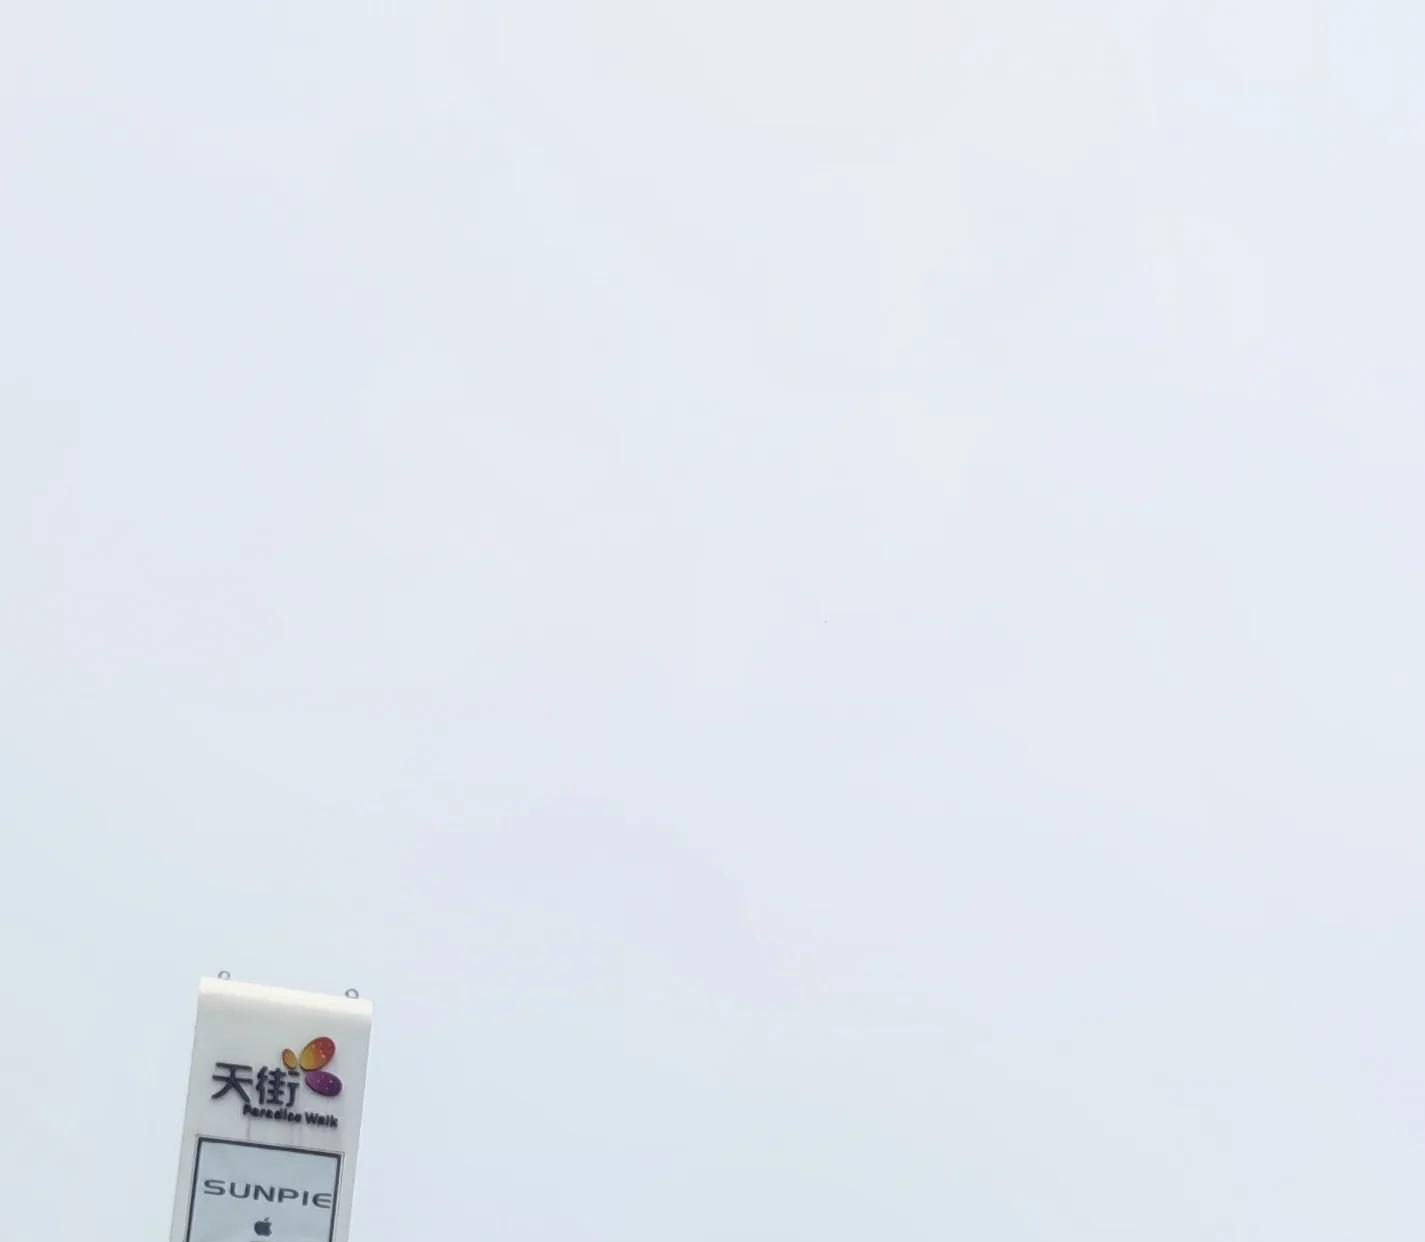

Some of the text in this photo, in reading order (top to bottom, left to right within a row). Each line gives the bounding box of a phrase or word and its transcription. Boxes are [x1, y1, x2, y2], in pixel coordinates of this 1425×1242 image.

[211, 1062, 300, 1107] 天街
[243, 1104, 338, 1128] Paradise Walk
[203, 1179, 333, 1209] SUNPIE
